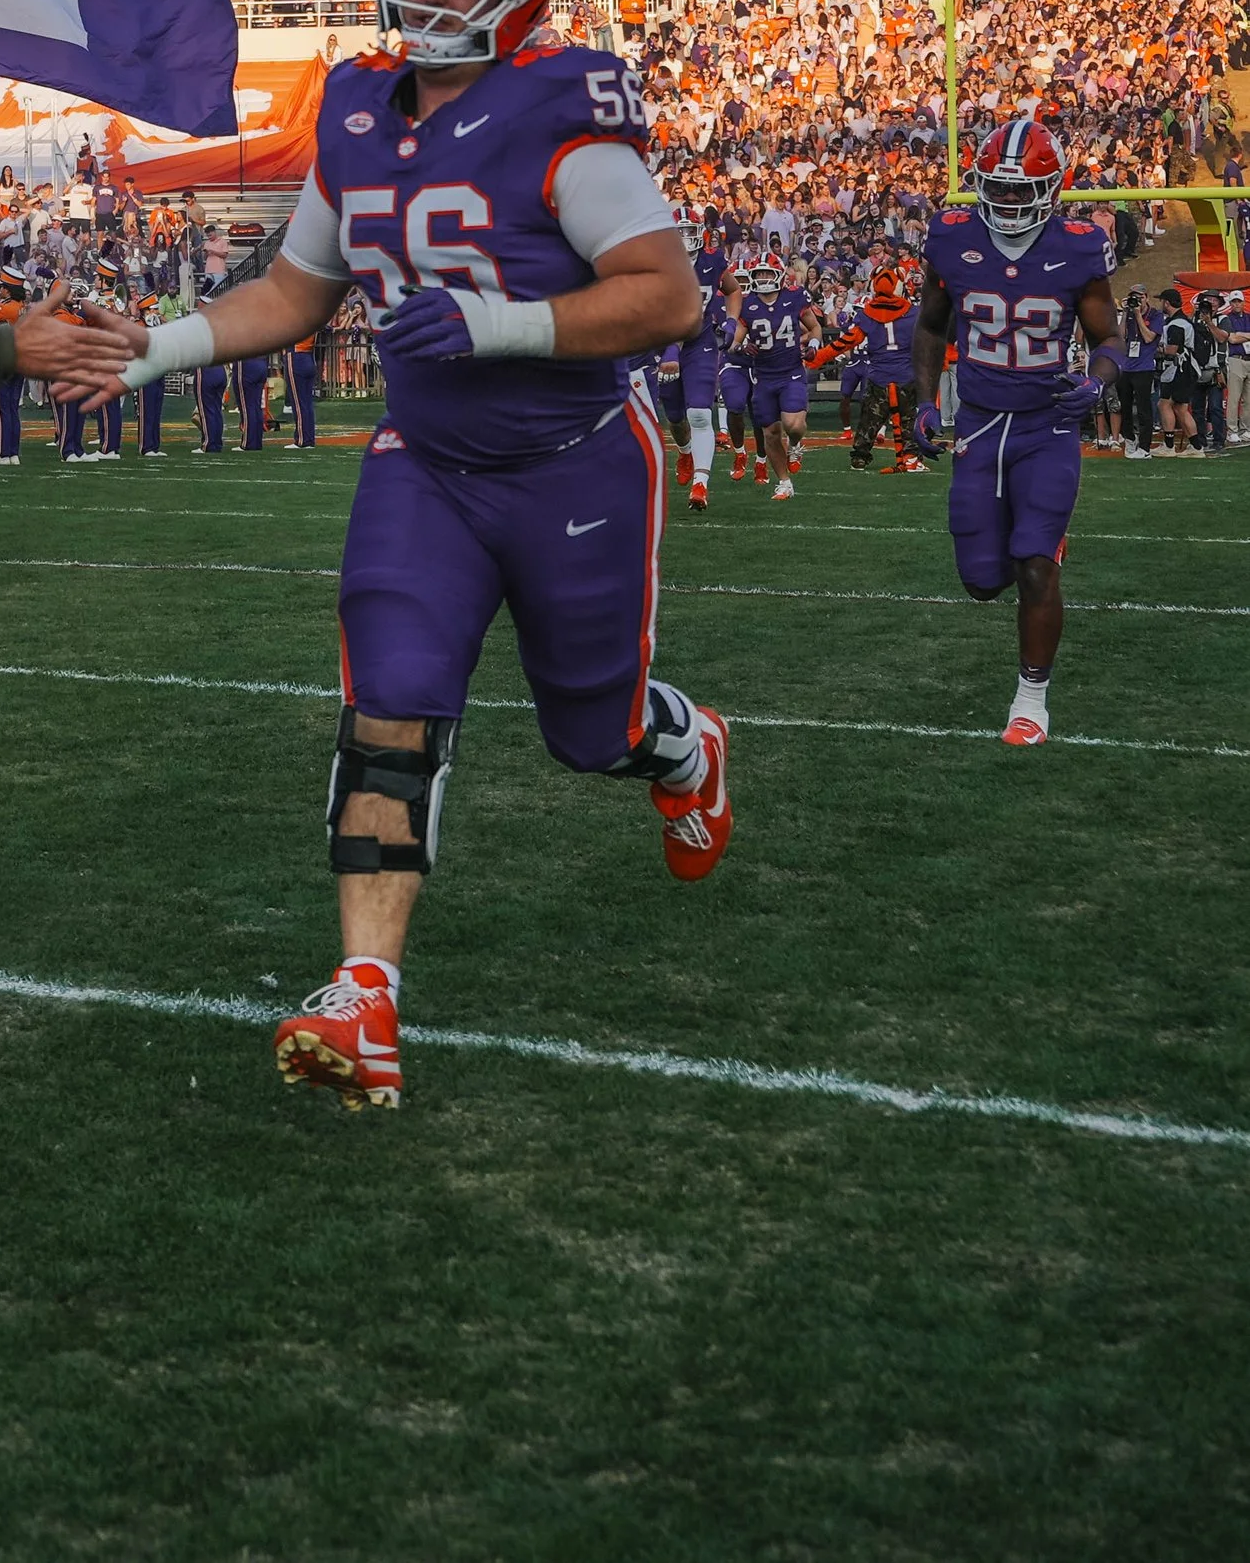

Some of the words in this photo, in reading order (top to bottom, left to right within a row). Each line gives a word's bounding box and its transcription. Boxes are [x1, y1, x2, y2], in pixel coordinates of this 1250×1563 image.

[585, 70, 645, 126] 56
[339, 182, 513, 332] 56
[1102, 241, 1118, 272] 2
[752, 315, 796, 350] 34
[884, 321, 898, 350] 1
[961, 290, 1064, 369] 22
